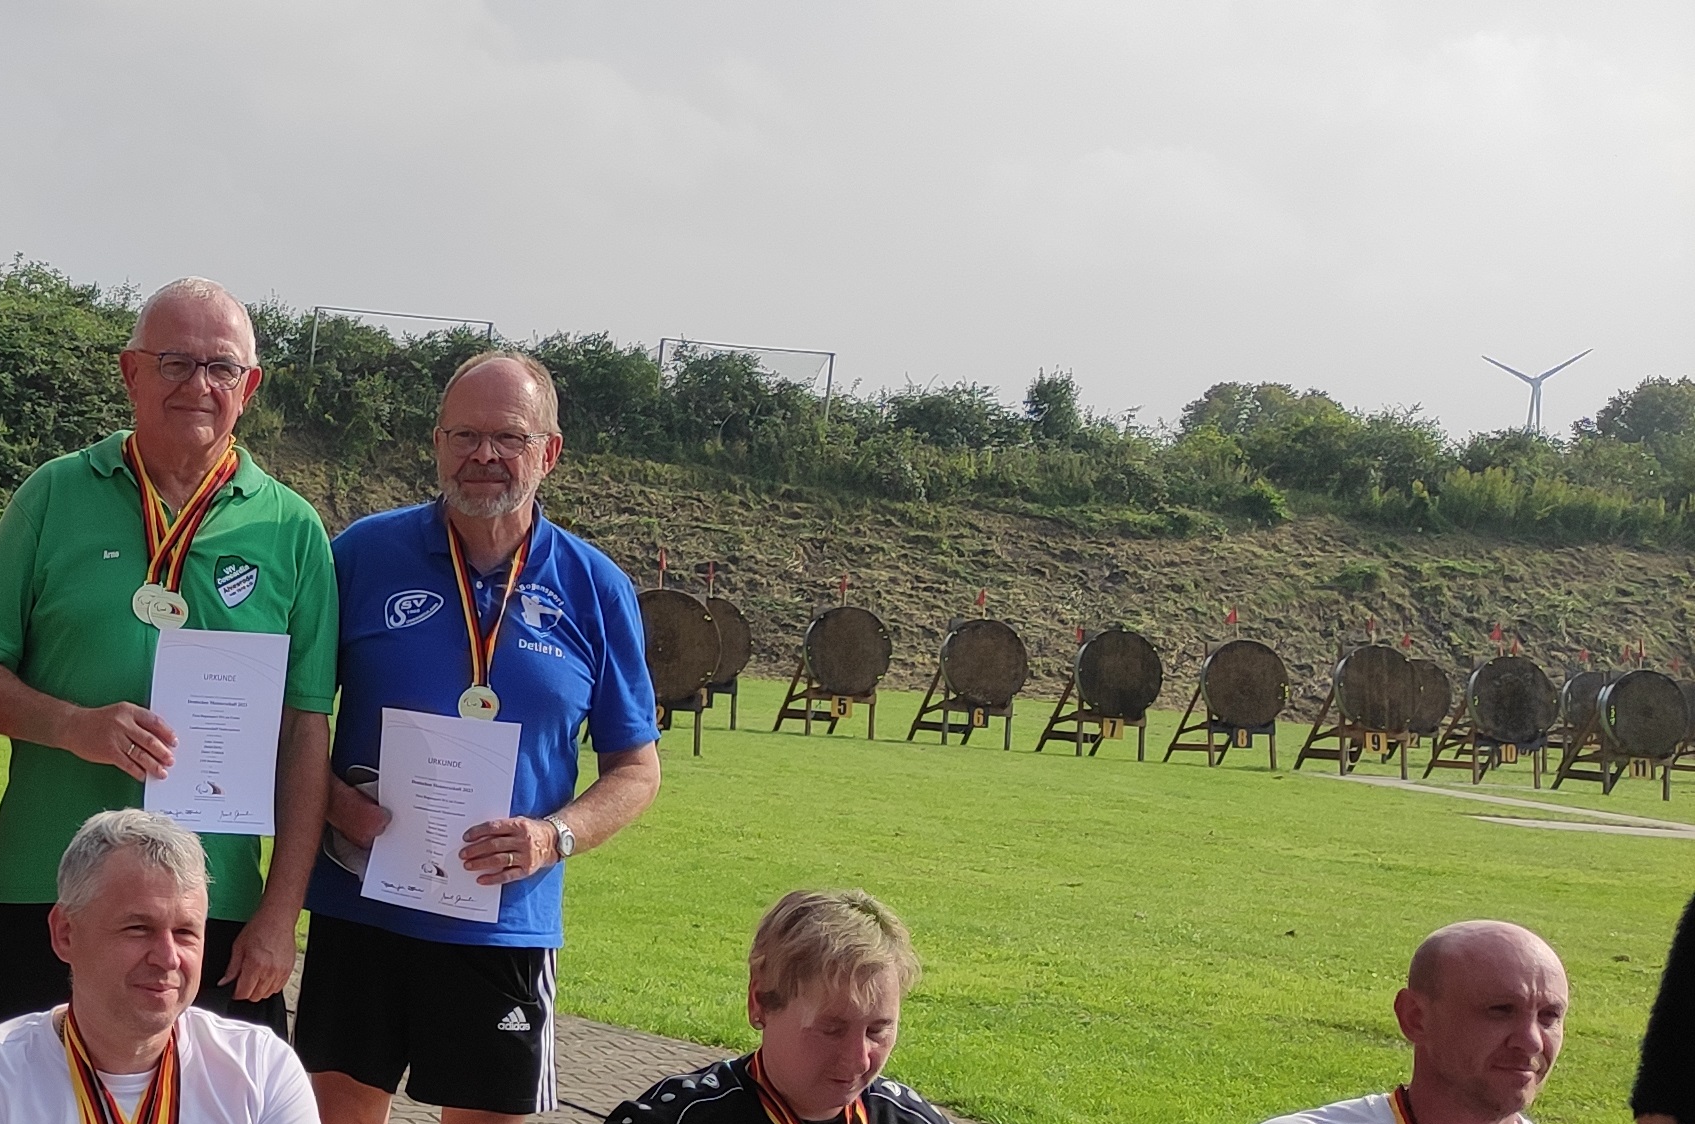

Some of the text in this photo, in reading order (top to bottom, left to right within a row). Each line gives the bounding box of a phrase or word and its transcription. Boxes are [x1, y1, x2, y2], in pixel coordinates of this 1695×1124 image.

[836, 697, 847, 716] 5
[973, 708, 984, 727] 6
[1108, 720, 1118, 738] 7
[1237, 728, 1248, 747] 8
[1370, 732, 1381, 751] 9
[428, 757, 462, 768] URKUNDE
[1499, 744, 1516, 763] 10
[1632, 760, 1648, 777] 11
